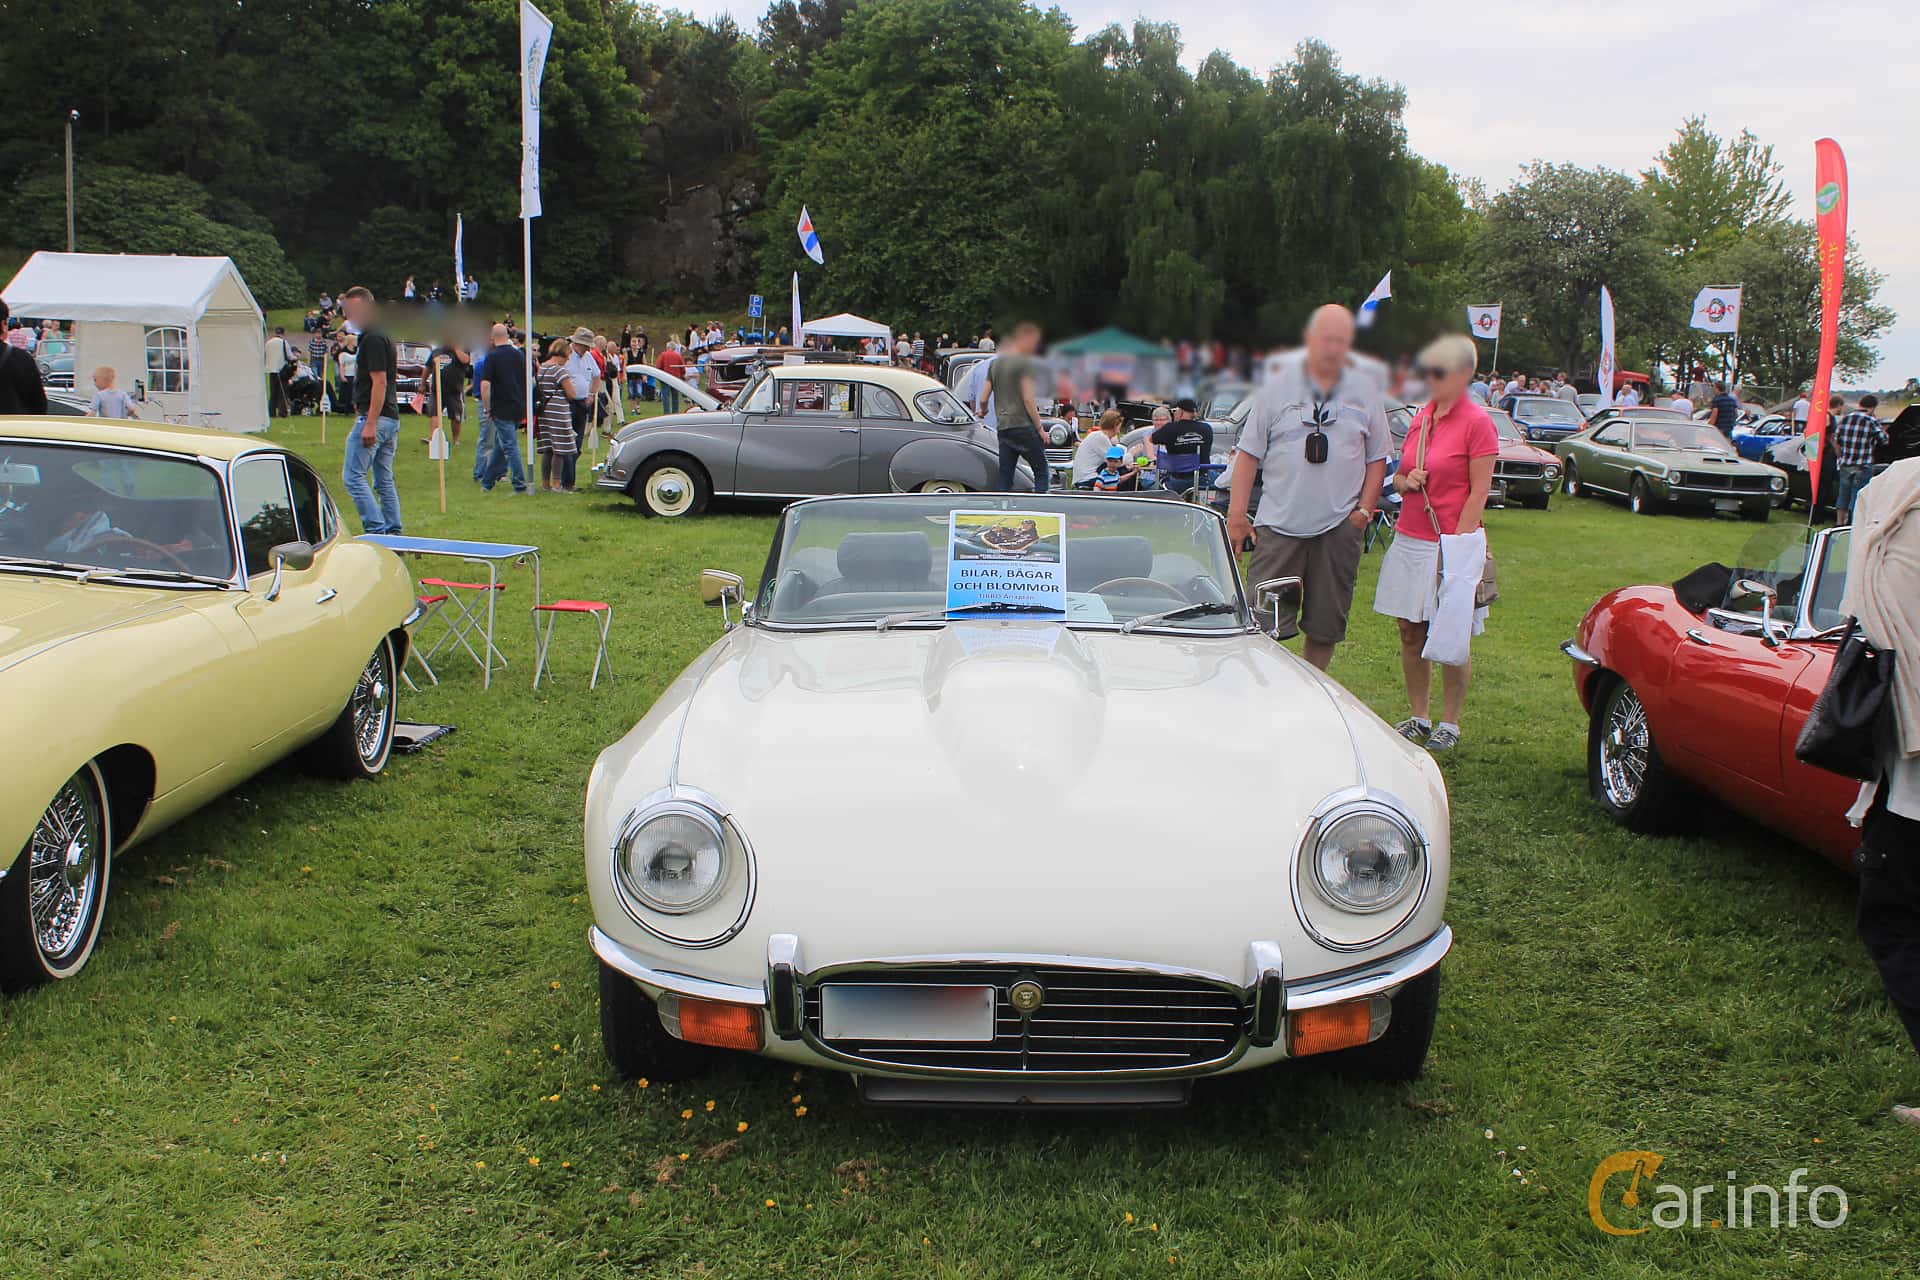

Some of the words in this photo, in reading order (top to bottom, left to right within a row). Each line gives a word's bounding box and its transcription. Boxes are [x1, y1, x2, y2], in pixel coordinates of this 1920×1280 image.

[961, 569, 1002, 578] BILAR,
[953, 582, 982, 591] OCH
[986, 582, 1060, 593] BLOMMOR
